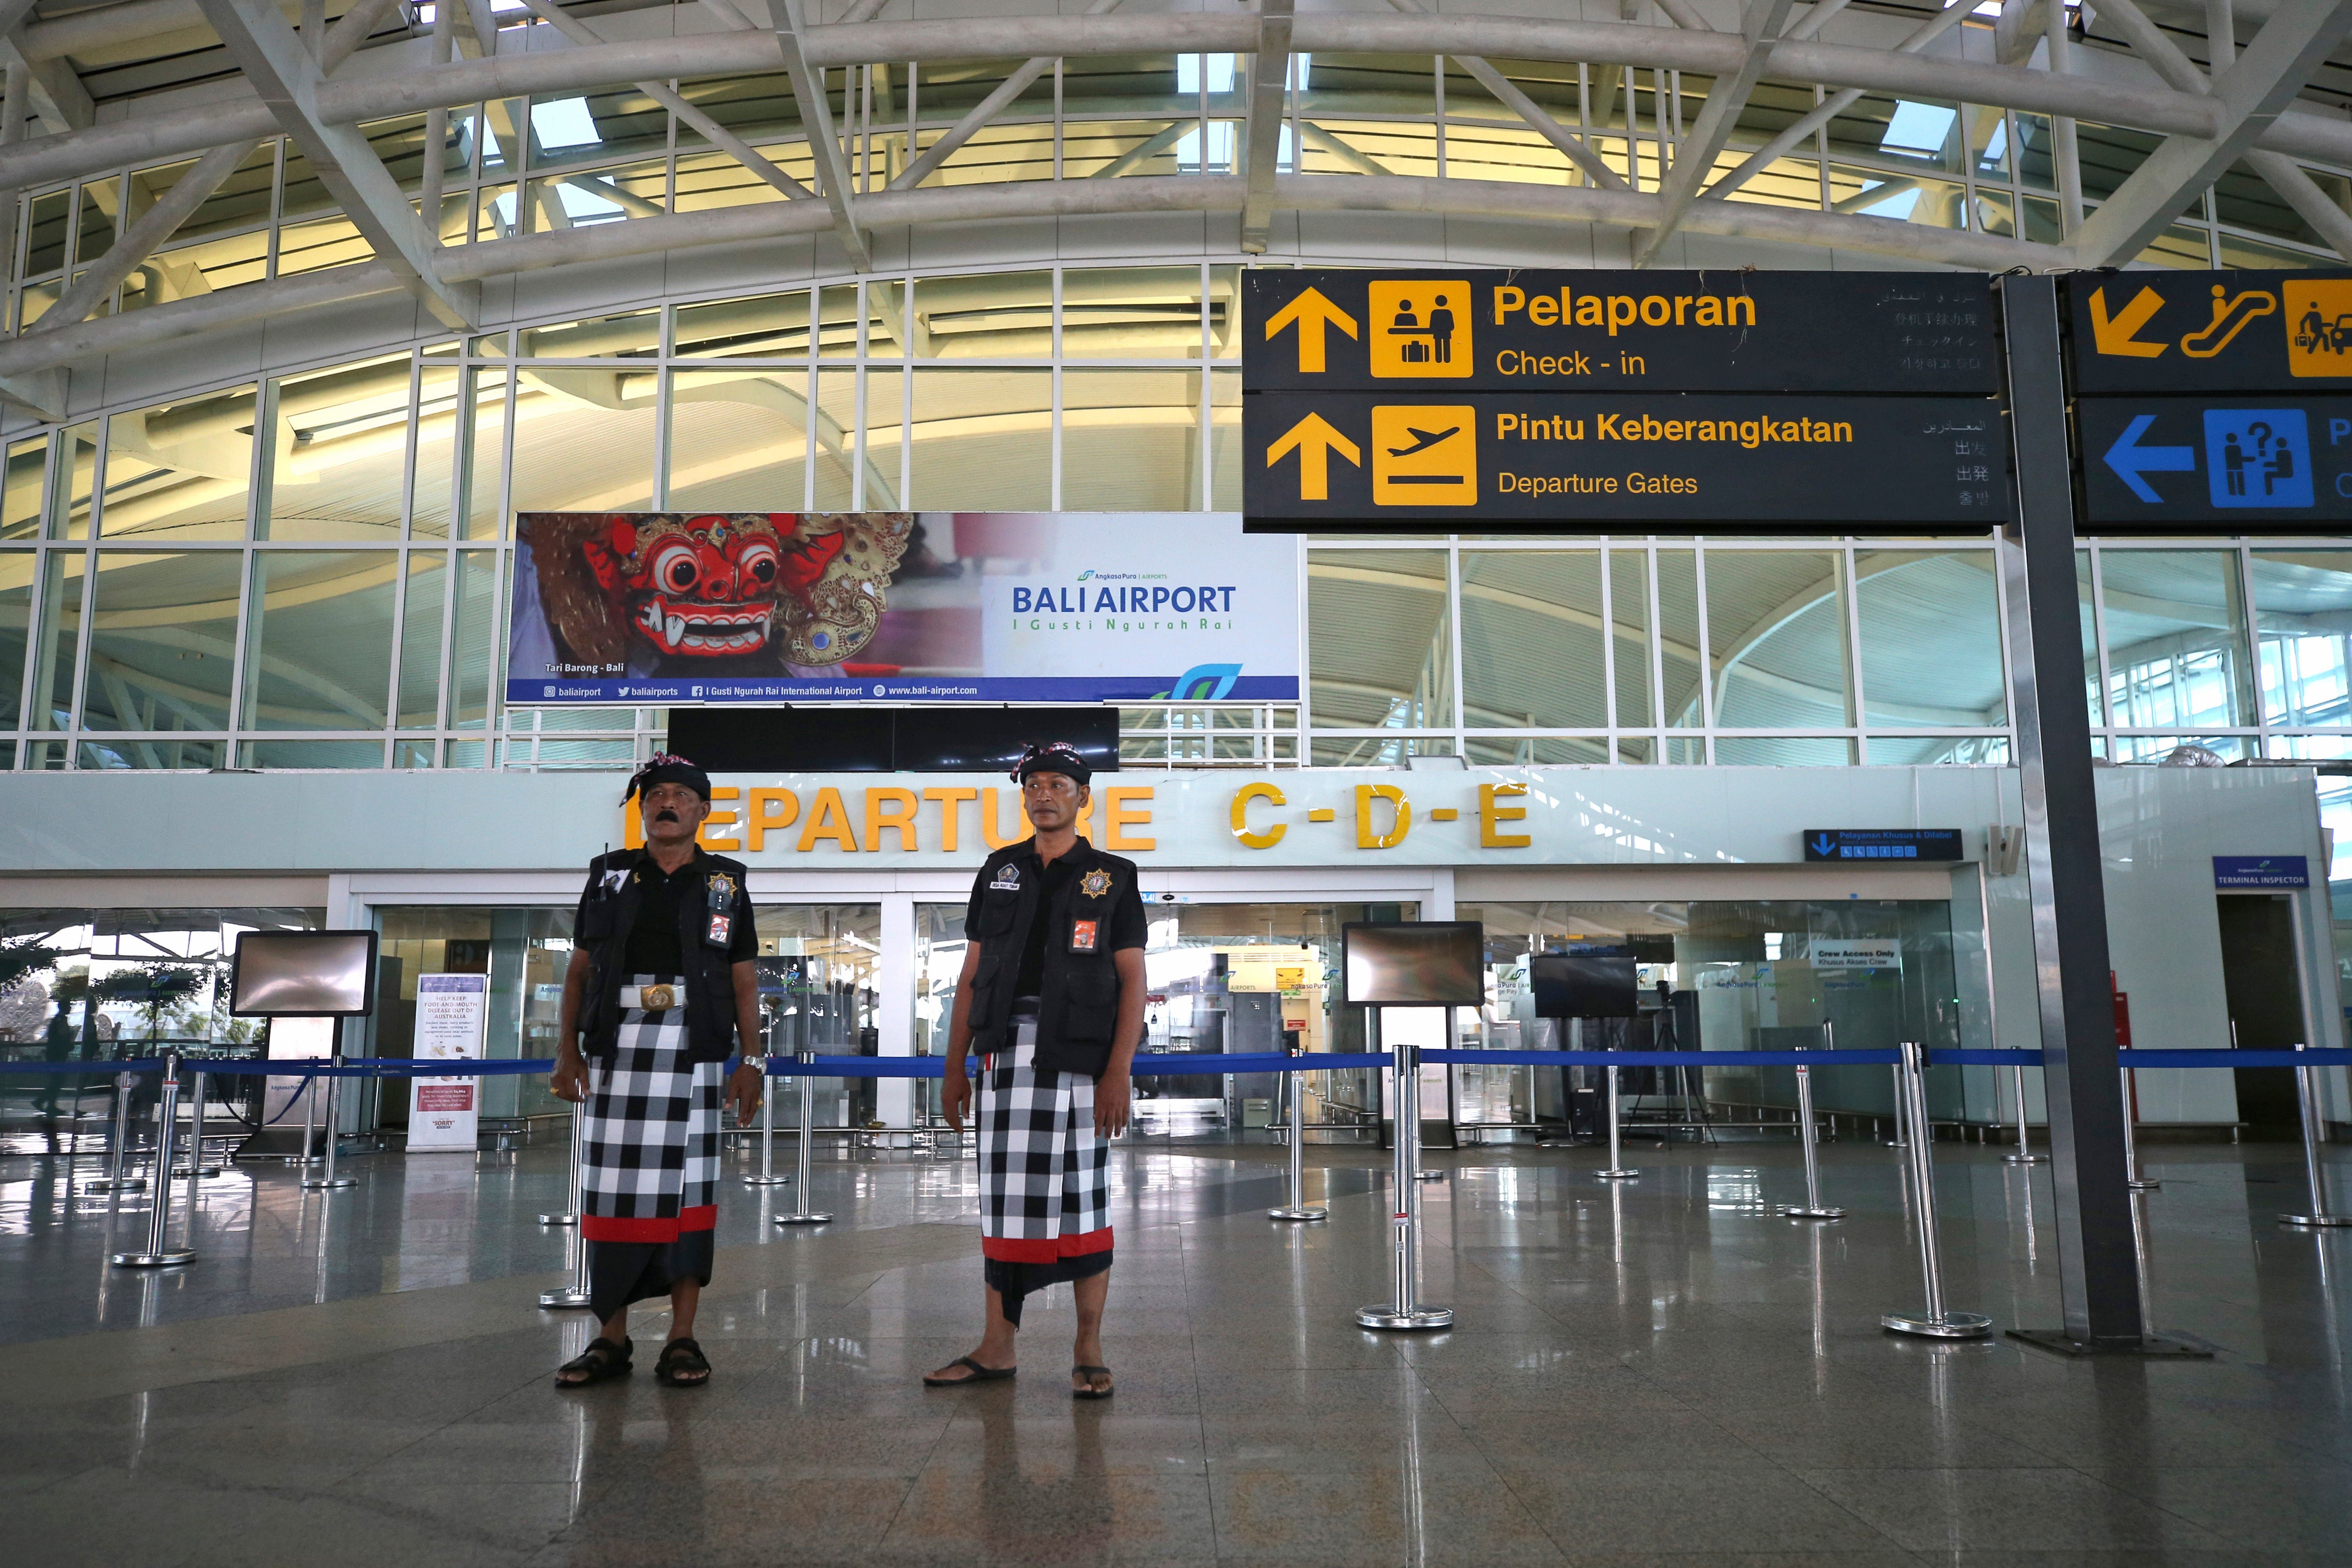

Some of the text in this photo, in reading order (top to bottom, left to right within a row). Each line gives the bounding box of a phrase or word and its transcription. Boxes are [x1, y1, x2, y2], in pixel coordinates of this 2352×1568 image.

[1493, 286, 1758, 335] Pelaporan
[1497, 350, 1591, 375] Check
[1620, 350, 1645, 375] in
[1497, 414, 1853, 449] Pintu Keberangkatan
[1957, 465, 1989, 481] 出発
[1499, 472, 1698, 499] Departure Gates
[1013, 587, 1236, 612] BALI AIRPORT
[1031, 619, 1092, 630] Gusti
[1106, 618, 1188, 632] Ngurah
[1200, 618, 1232, 630] Rai
[565, 664, 598, 674] Barong
[606, 664, 624, 672] Bali
[559, 687, 601, 697] baliairport
[632, 686, 678, 696] baliairports
[711, 687, 732, 696] Gusti
[734, 687, 763, 696] Ngurah
[766, 687, 779, 696] Rai
[781, 687, 833, 696] International
[835, 687, 863, 696] Airport
[889, 686, 977, 696] www.bali-airport.com
[624, 787, 1155, 853] EPARTUE
[1840, 831, 1881, 840] Pelayanan
